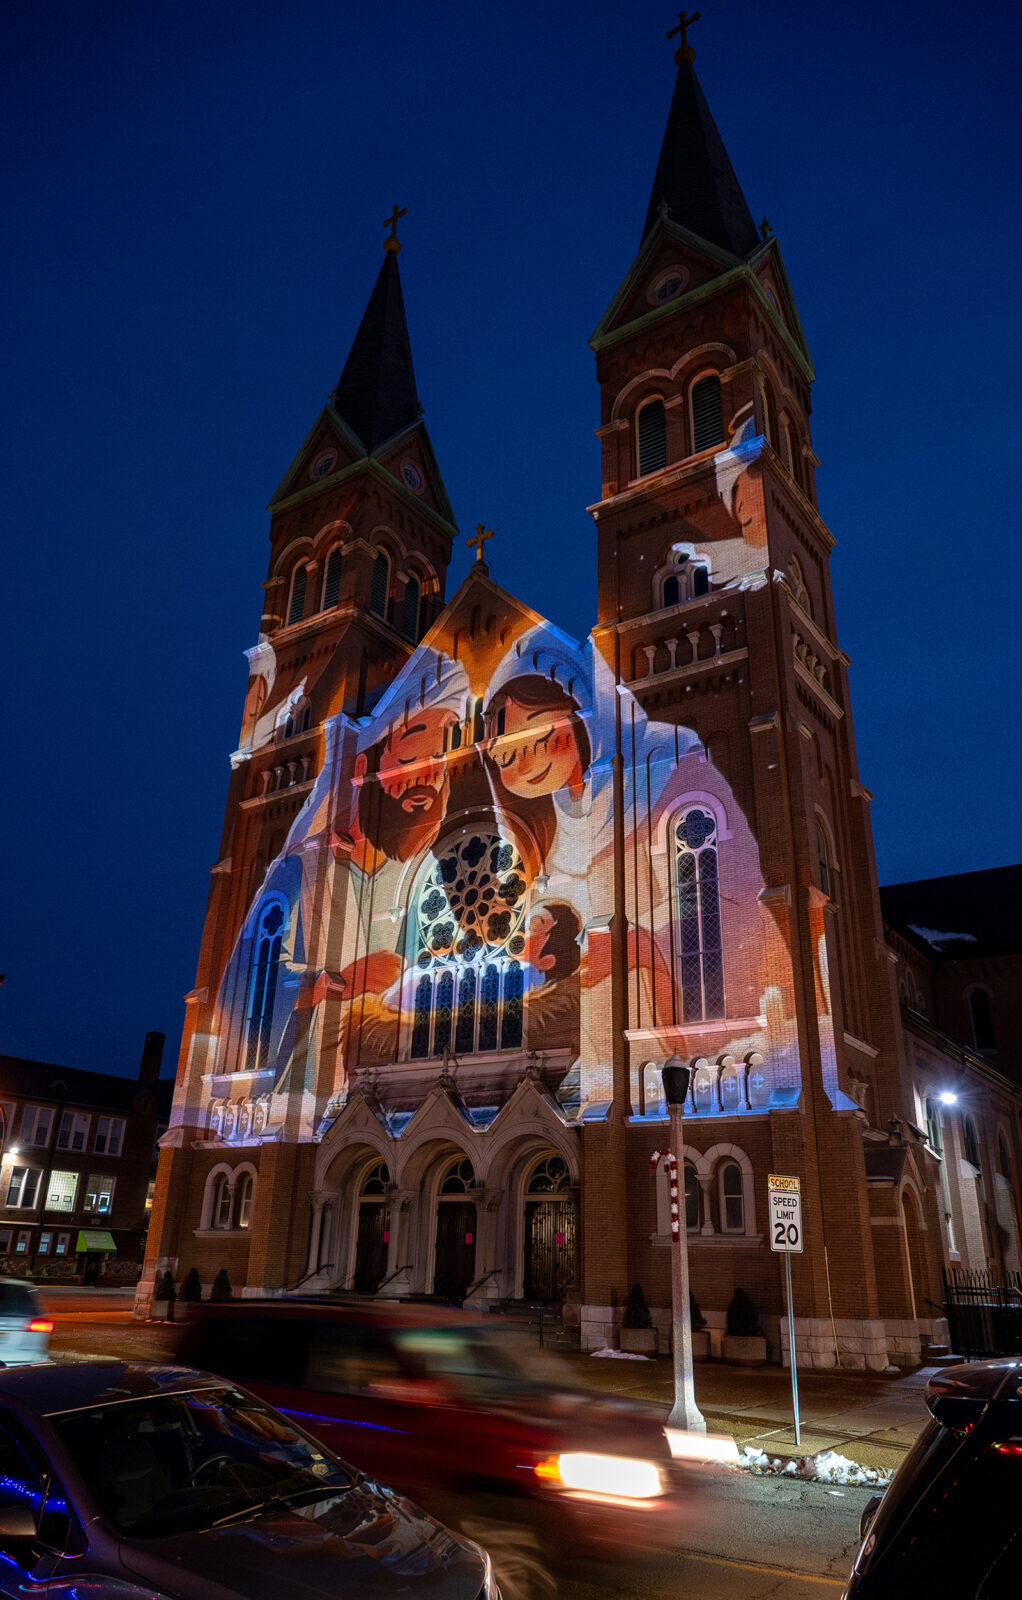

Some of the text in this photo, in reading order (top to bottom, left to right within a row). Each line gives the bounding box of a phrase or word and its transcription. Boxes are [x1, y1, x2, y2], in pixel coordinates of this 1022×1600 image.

[770, 1178, 798, 1190] SCHOOL
[773, 1196, 798, 1208] SPEED
[776, 1209, 795, 1220] LIMIT
[774, 1222, 799, 1246] 20
